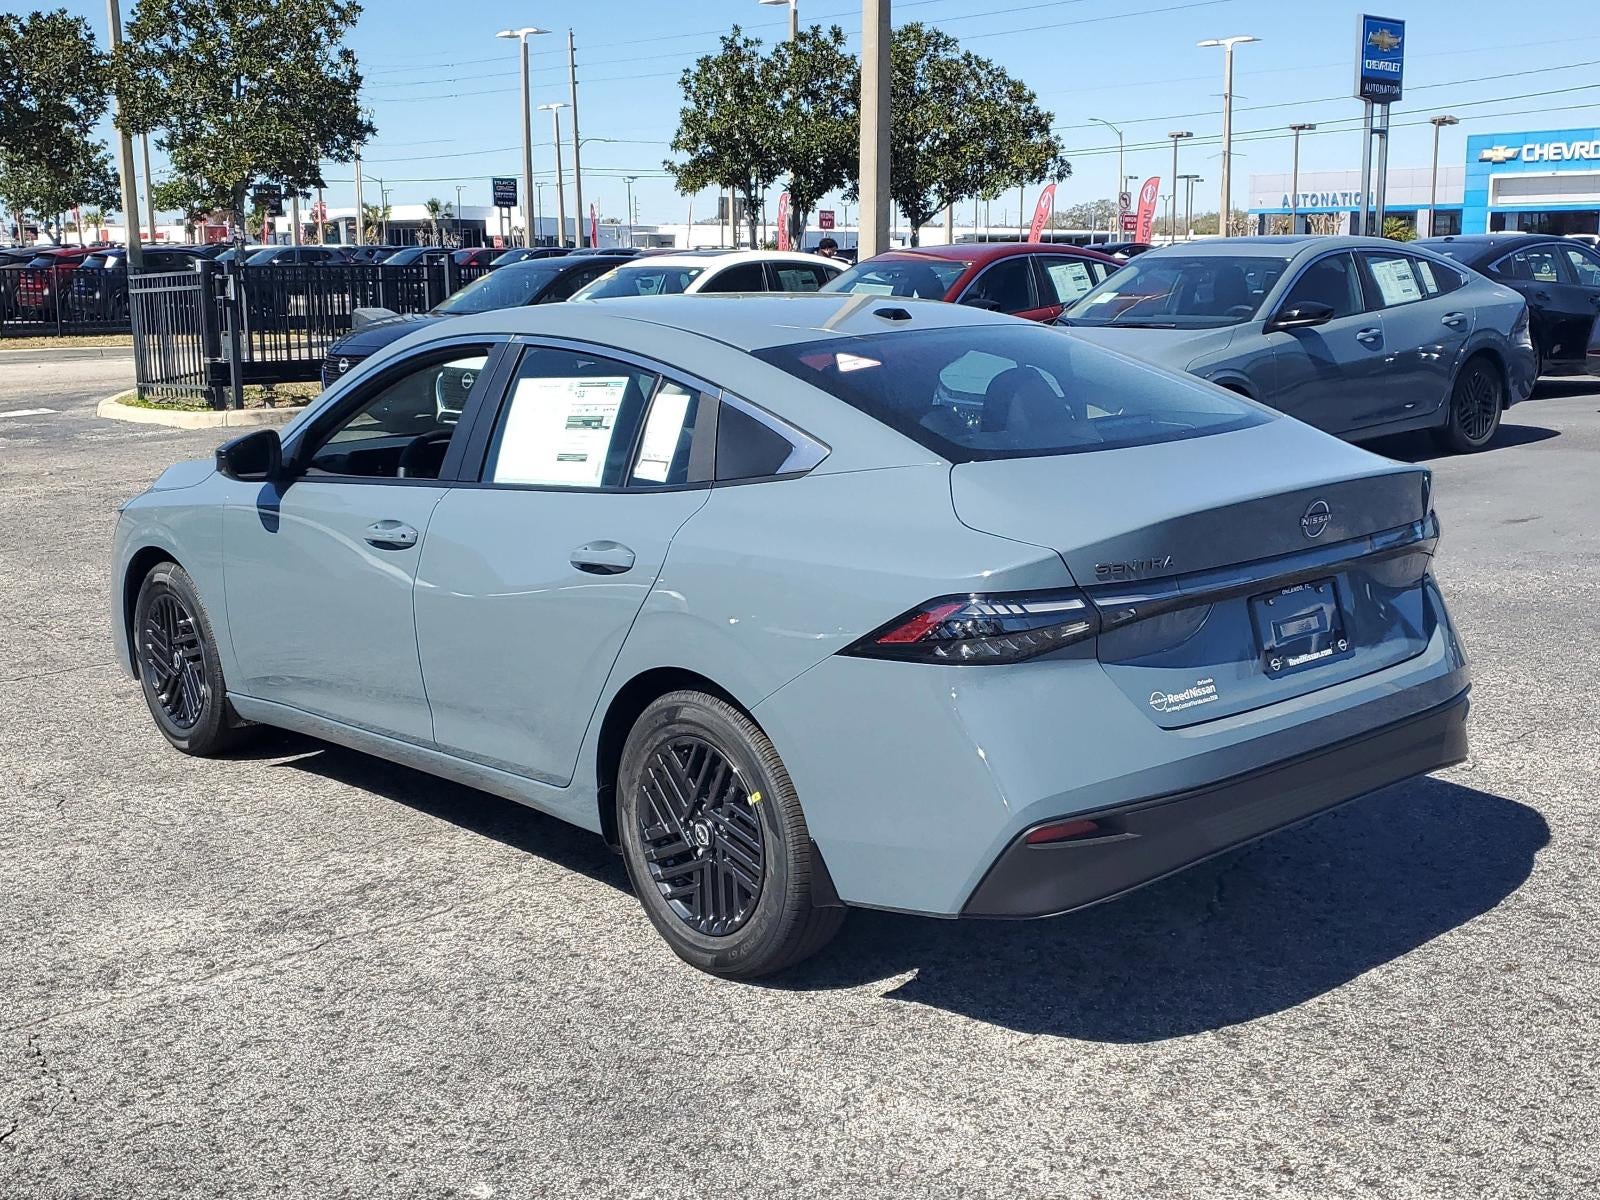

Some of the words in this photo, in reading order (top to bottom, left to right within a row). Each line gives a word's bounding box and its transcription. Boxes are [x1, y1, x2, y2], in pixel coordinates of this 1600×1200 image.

[1365, 59, 1401, 73] CHEVROLET
[1364, 83, 1400, 95] AUTONATION
[1301, 514, 1332, 526] NISSAN
[1095, 555, 1175, 575] SENTRA
